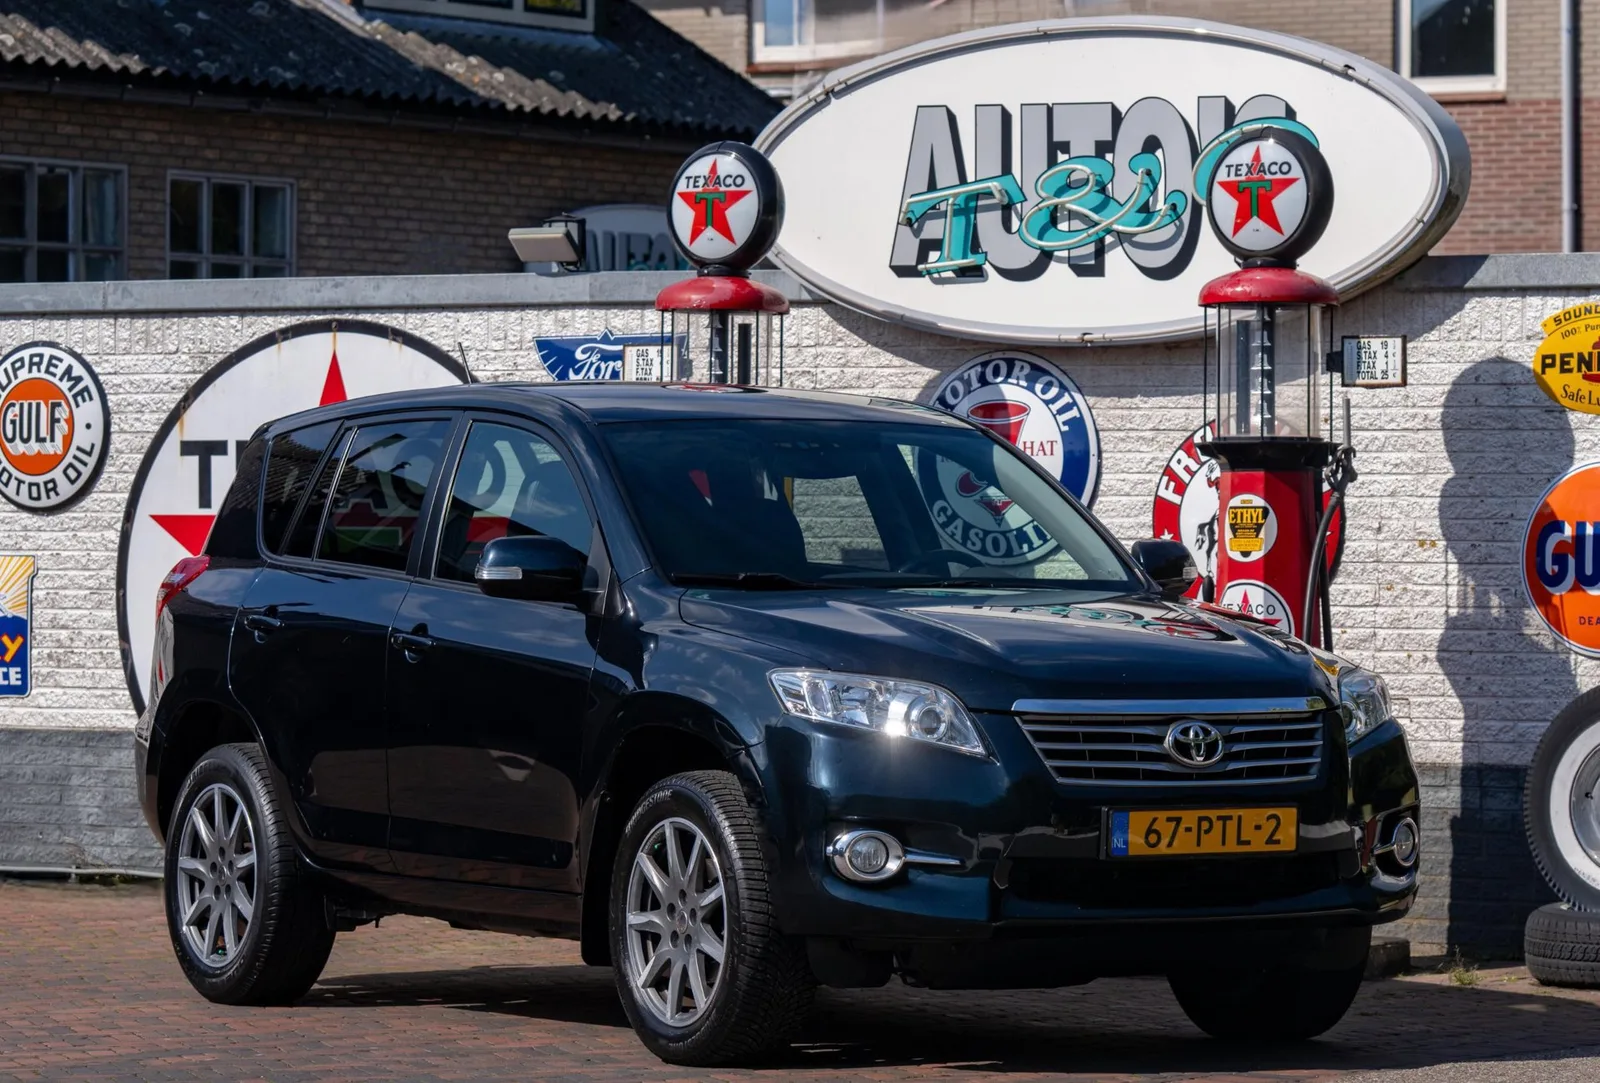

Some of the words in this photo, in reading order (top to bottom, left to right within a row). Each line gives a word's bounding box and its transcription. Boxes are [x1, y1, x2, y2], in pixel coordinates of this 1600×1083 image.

[1225, 160, 1292, 178] TEXACO
[685, 174, 746, 189] TEXACO
[1238, 180, 1272, 218] T
[695, 191, 727, 227] T
[636, 348, 649, 358] GAS
[1357, 340, 1371, 350] GAS
[1380, 340, 1389, 350] 19
[569, 343, 624, 380] For
[636, 358, 654, 367] S.TAX
[1384, 351, 1389, 360] 4
[1541, 351, 1600, 375] PEN
[0, 353, 93, 408] UPREME
[636, 367, 652, 377] F.TAX
[1357, 370, 1378, 380] TOTAL
[1380, 370, 1389, 380] 25
[935, 359, 1031, 412] OTOR
[1035, 375, 1080, 432] OIL
[1561, 384, 1586, 403] Safe
[3, 400, 66, 450] GULF
[1023, 440, 1057, 456] HAT
[0, 459, 60, 501] OTOR
[63, 442, 95, 486] OIL
[1229, 506, 1265, 525] ETHYL
[1143, 813, 1282, 848] 67-PTL-2
[1112, 838, 1126, 848] NL
